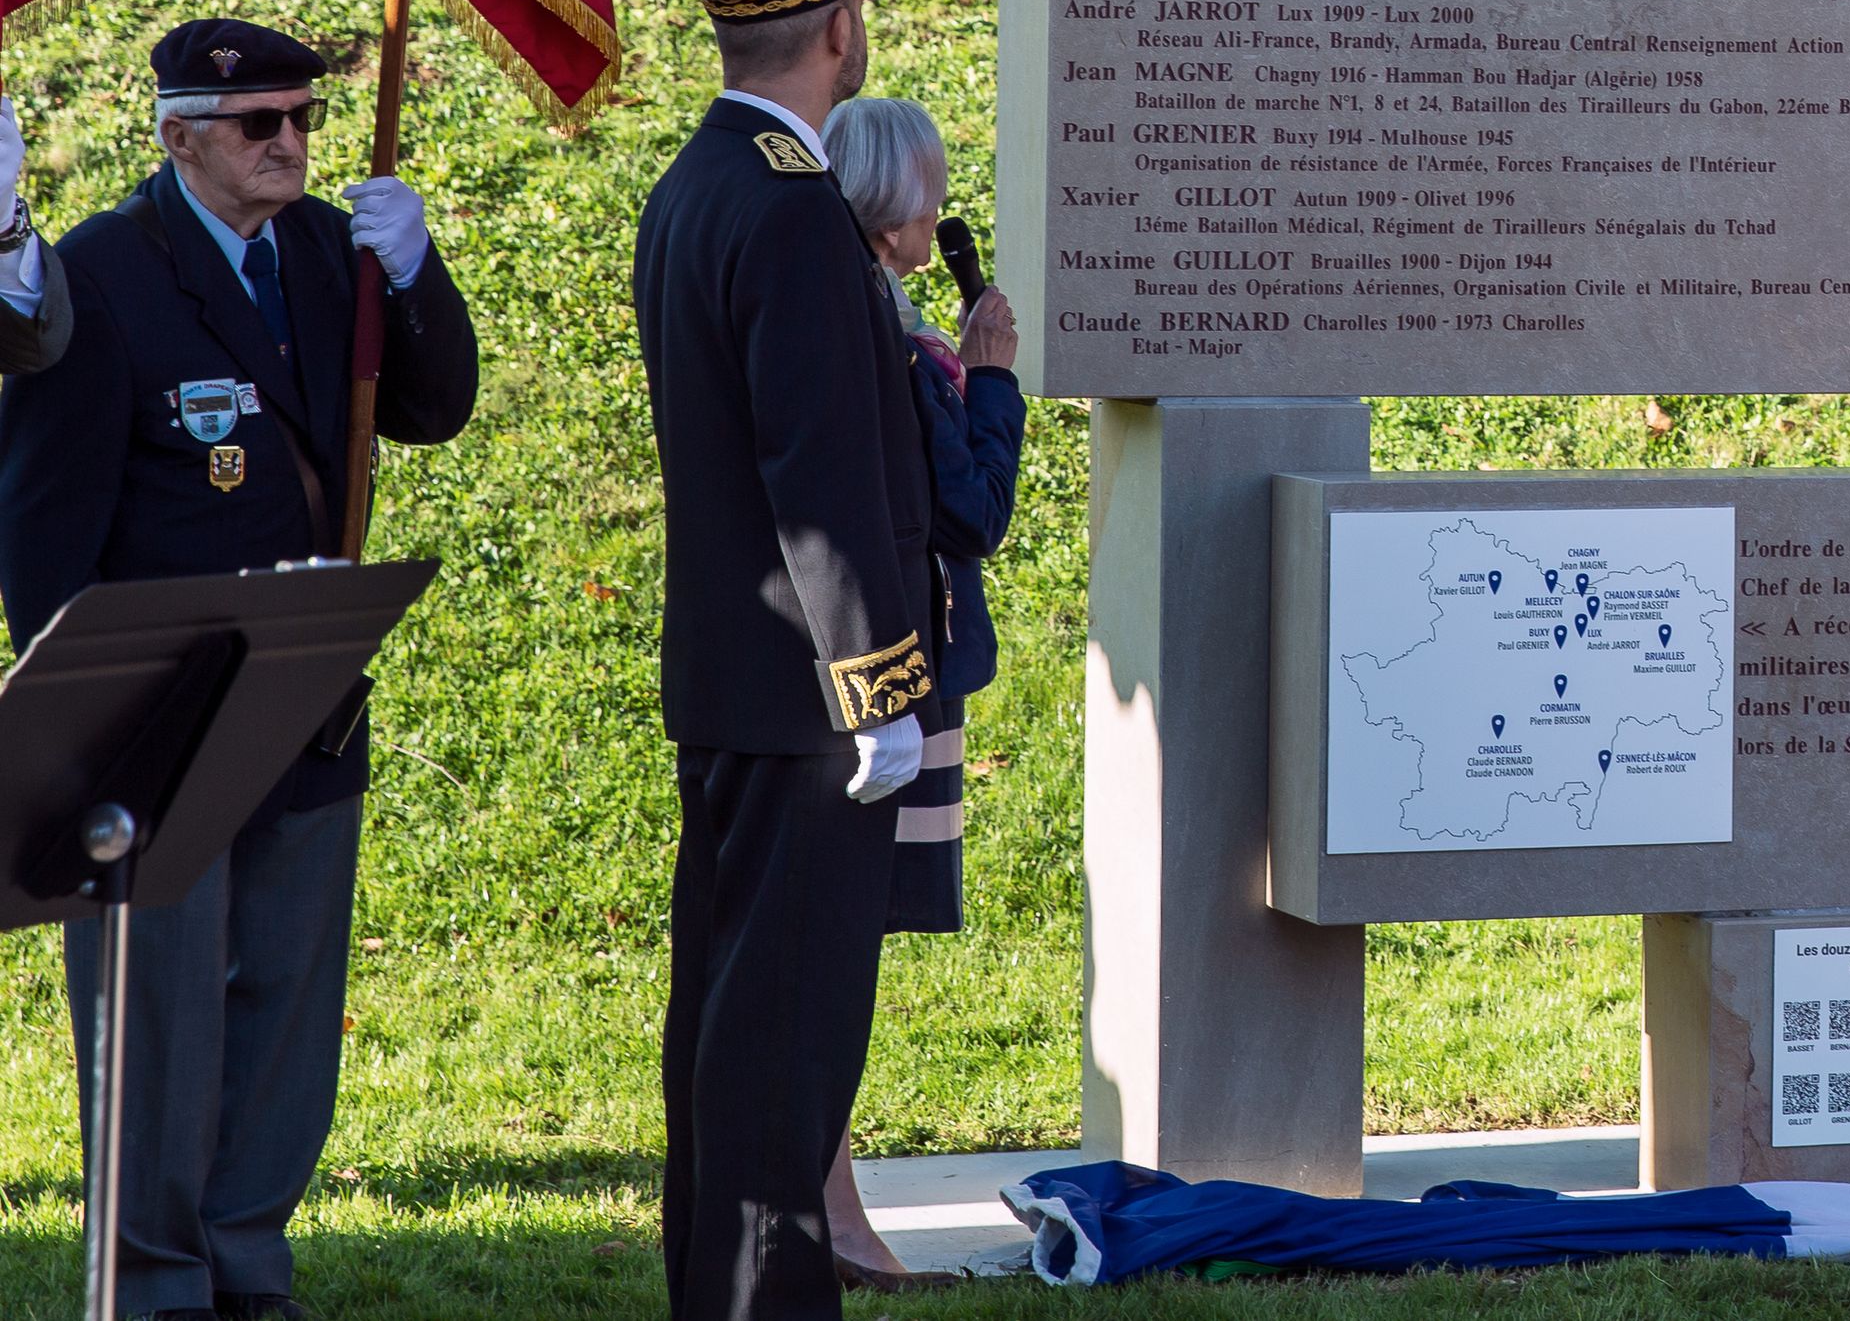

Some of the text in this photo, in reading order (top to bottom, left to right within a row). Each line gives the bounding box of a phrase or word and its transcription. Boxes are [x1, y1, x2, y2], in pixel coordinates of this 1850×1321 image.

[1064, 0, 1260, 22] André JARROT
[1064, 61, 1233, 82] Jean MAGNE
[1063, 123, 1257, 144] Paul GRENIER
[1061, 187, 1276, 207] Xavier GILLOT
[1059, 250, 1294, 270] Maxime GUILLOT
[1059, 312, 1289, 332] Claude BERNARD
[1568, 548, 1600, 557] CHAGNY
[1741, 540, 1812, 558] L'ordre
[1822, 540, 1844, 557] de
[1559, 561, 1607, 570] Jean MAGNE
[1459, 573, 1486, 583] AUTUN
[1434, 586, 1486, 595] Xavier GILLOT
[1525, 597, 1563, 606] MELLECEY
[1604, 601, 1669, 612] Raymond BASSET
[1494, 610, 1563, 619] Louis GAUTHERON
[1604, 611, 1663, 621] Firmin VERMEIL
[1784, 617, 1800, 636] A
[1529, 628, 1550, 637] BUXY
[1588, 629, 1602, 637] LUX
[1498, 641, 1549, 650] Paul GRENIER
[1611, 641, 1640, 650] JARROT
[1645, 652, 1685, 661] BRUAILLES
[1633, 664, 1696, 673] Maxime GUILLOT
[1740, 657, 1849, 676] militaires
[1540, 703, 1580, 712] CORMATIN
[1530, 715, 1590, 725] Pierre BRUSSON
[1478, 745, 1522, 754] CHAROLLES
[1467, 756, 1532, 766] Claude BERNARD
[1466, 767, 1533, 778] Claude CHANDON
[1626, 765, 1652, 774] Robert
[1664, 764, 1686, 773] ROUX
[1797, 945, 1818, 956] Les
